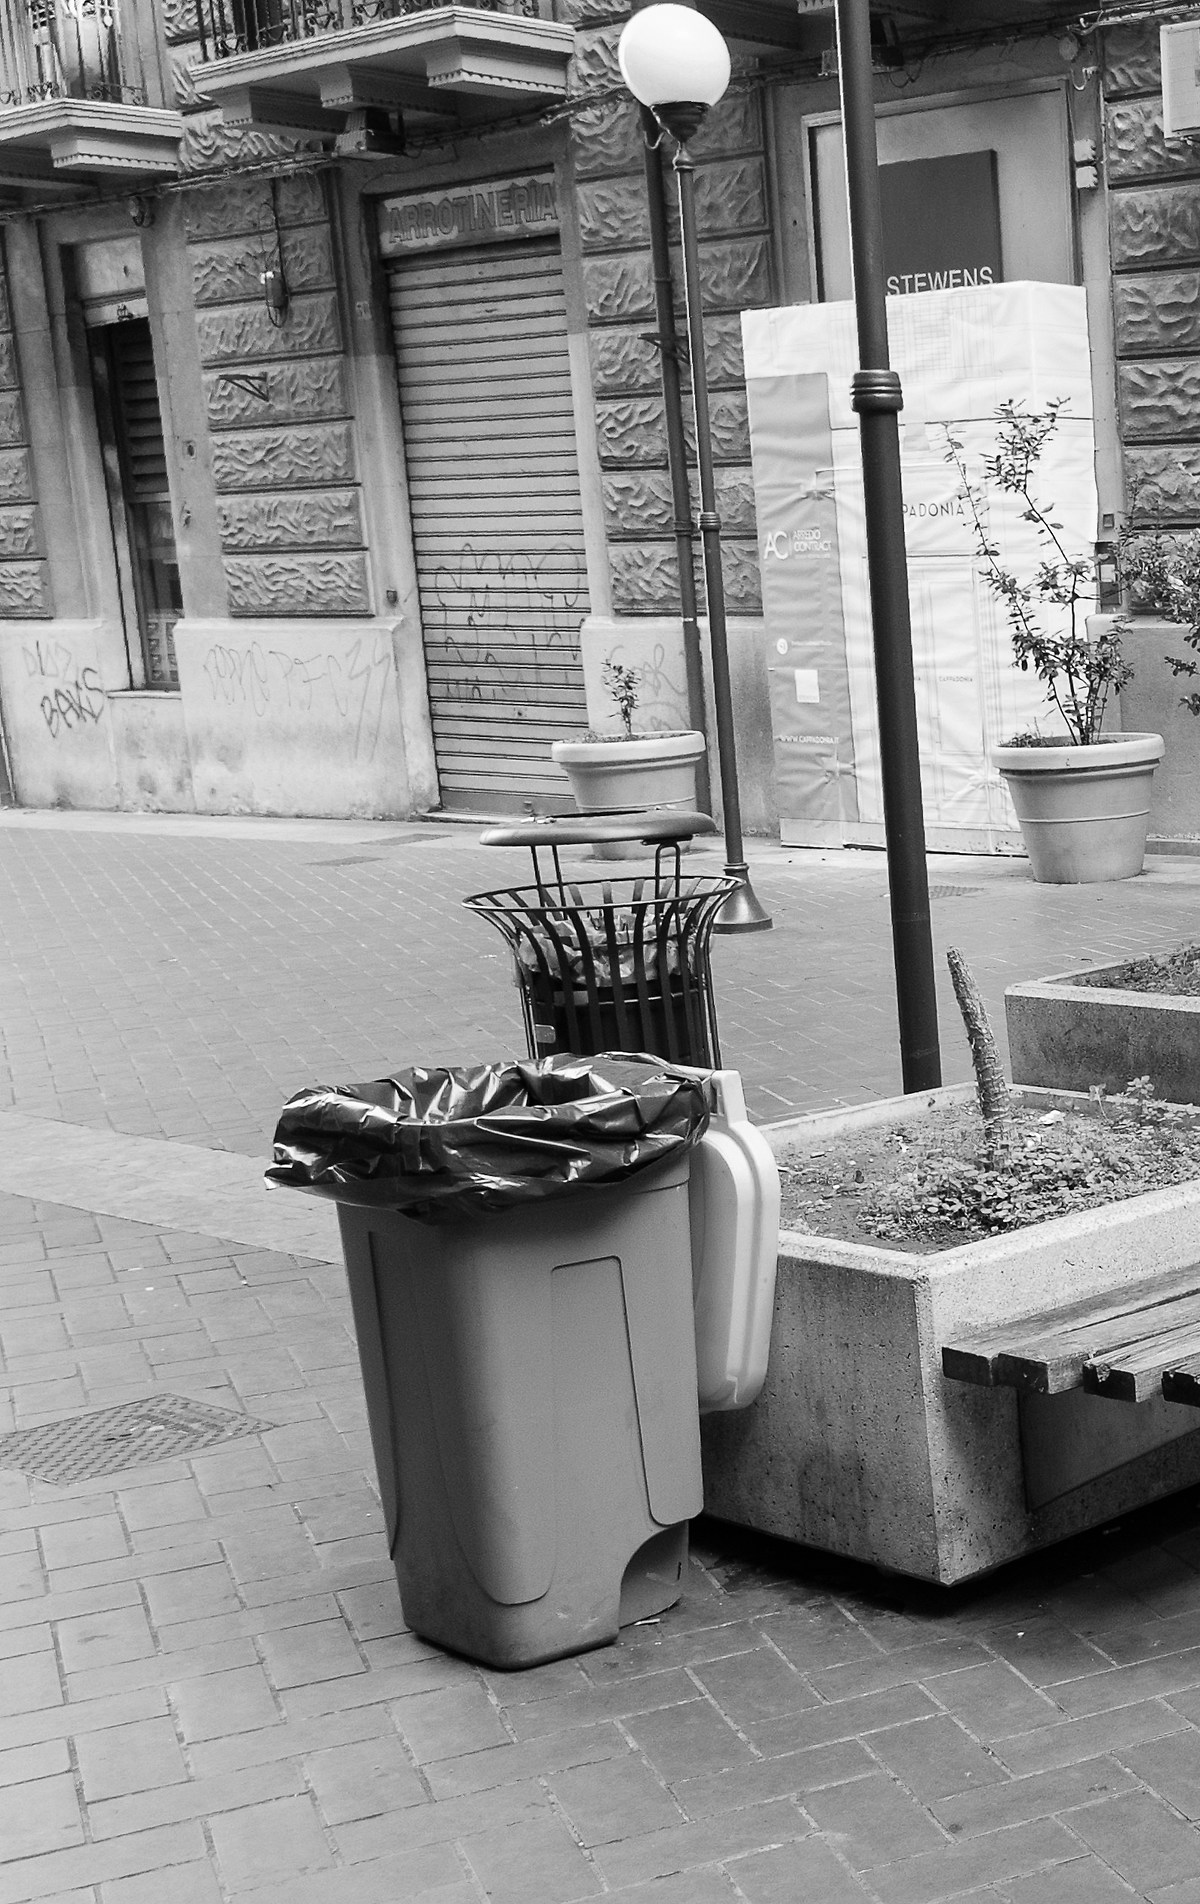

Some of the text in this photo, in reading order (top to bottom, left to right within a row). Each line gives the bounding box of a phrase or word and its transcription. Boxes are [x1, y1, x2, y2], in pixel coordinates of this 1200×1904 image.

[389, 181, 559, 243] ARROTINERIA
[886, 266, 993, 296] STEWENS
[763, 530, 789, 560] AC
[793, 540, 832, 552] CONTRACT
